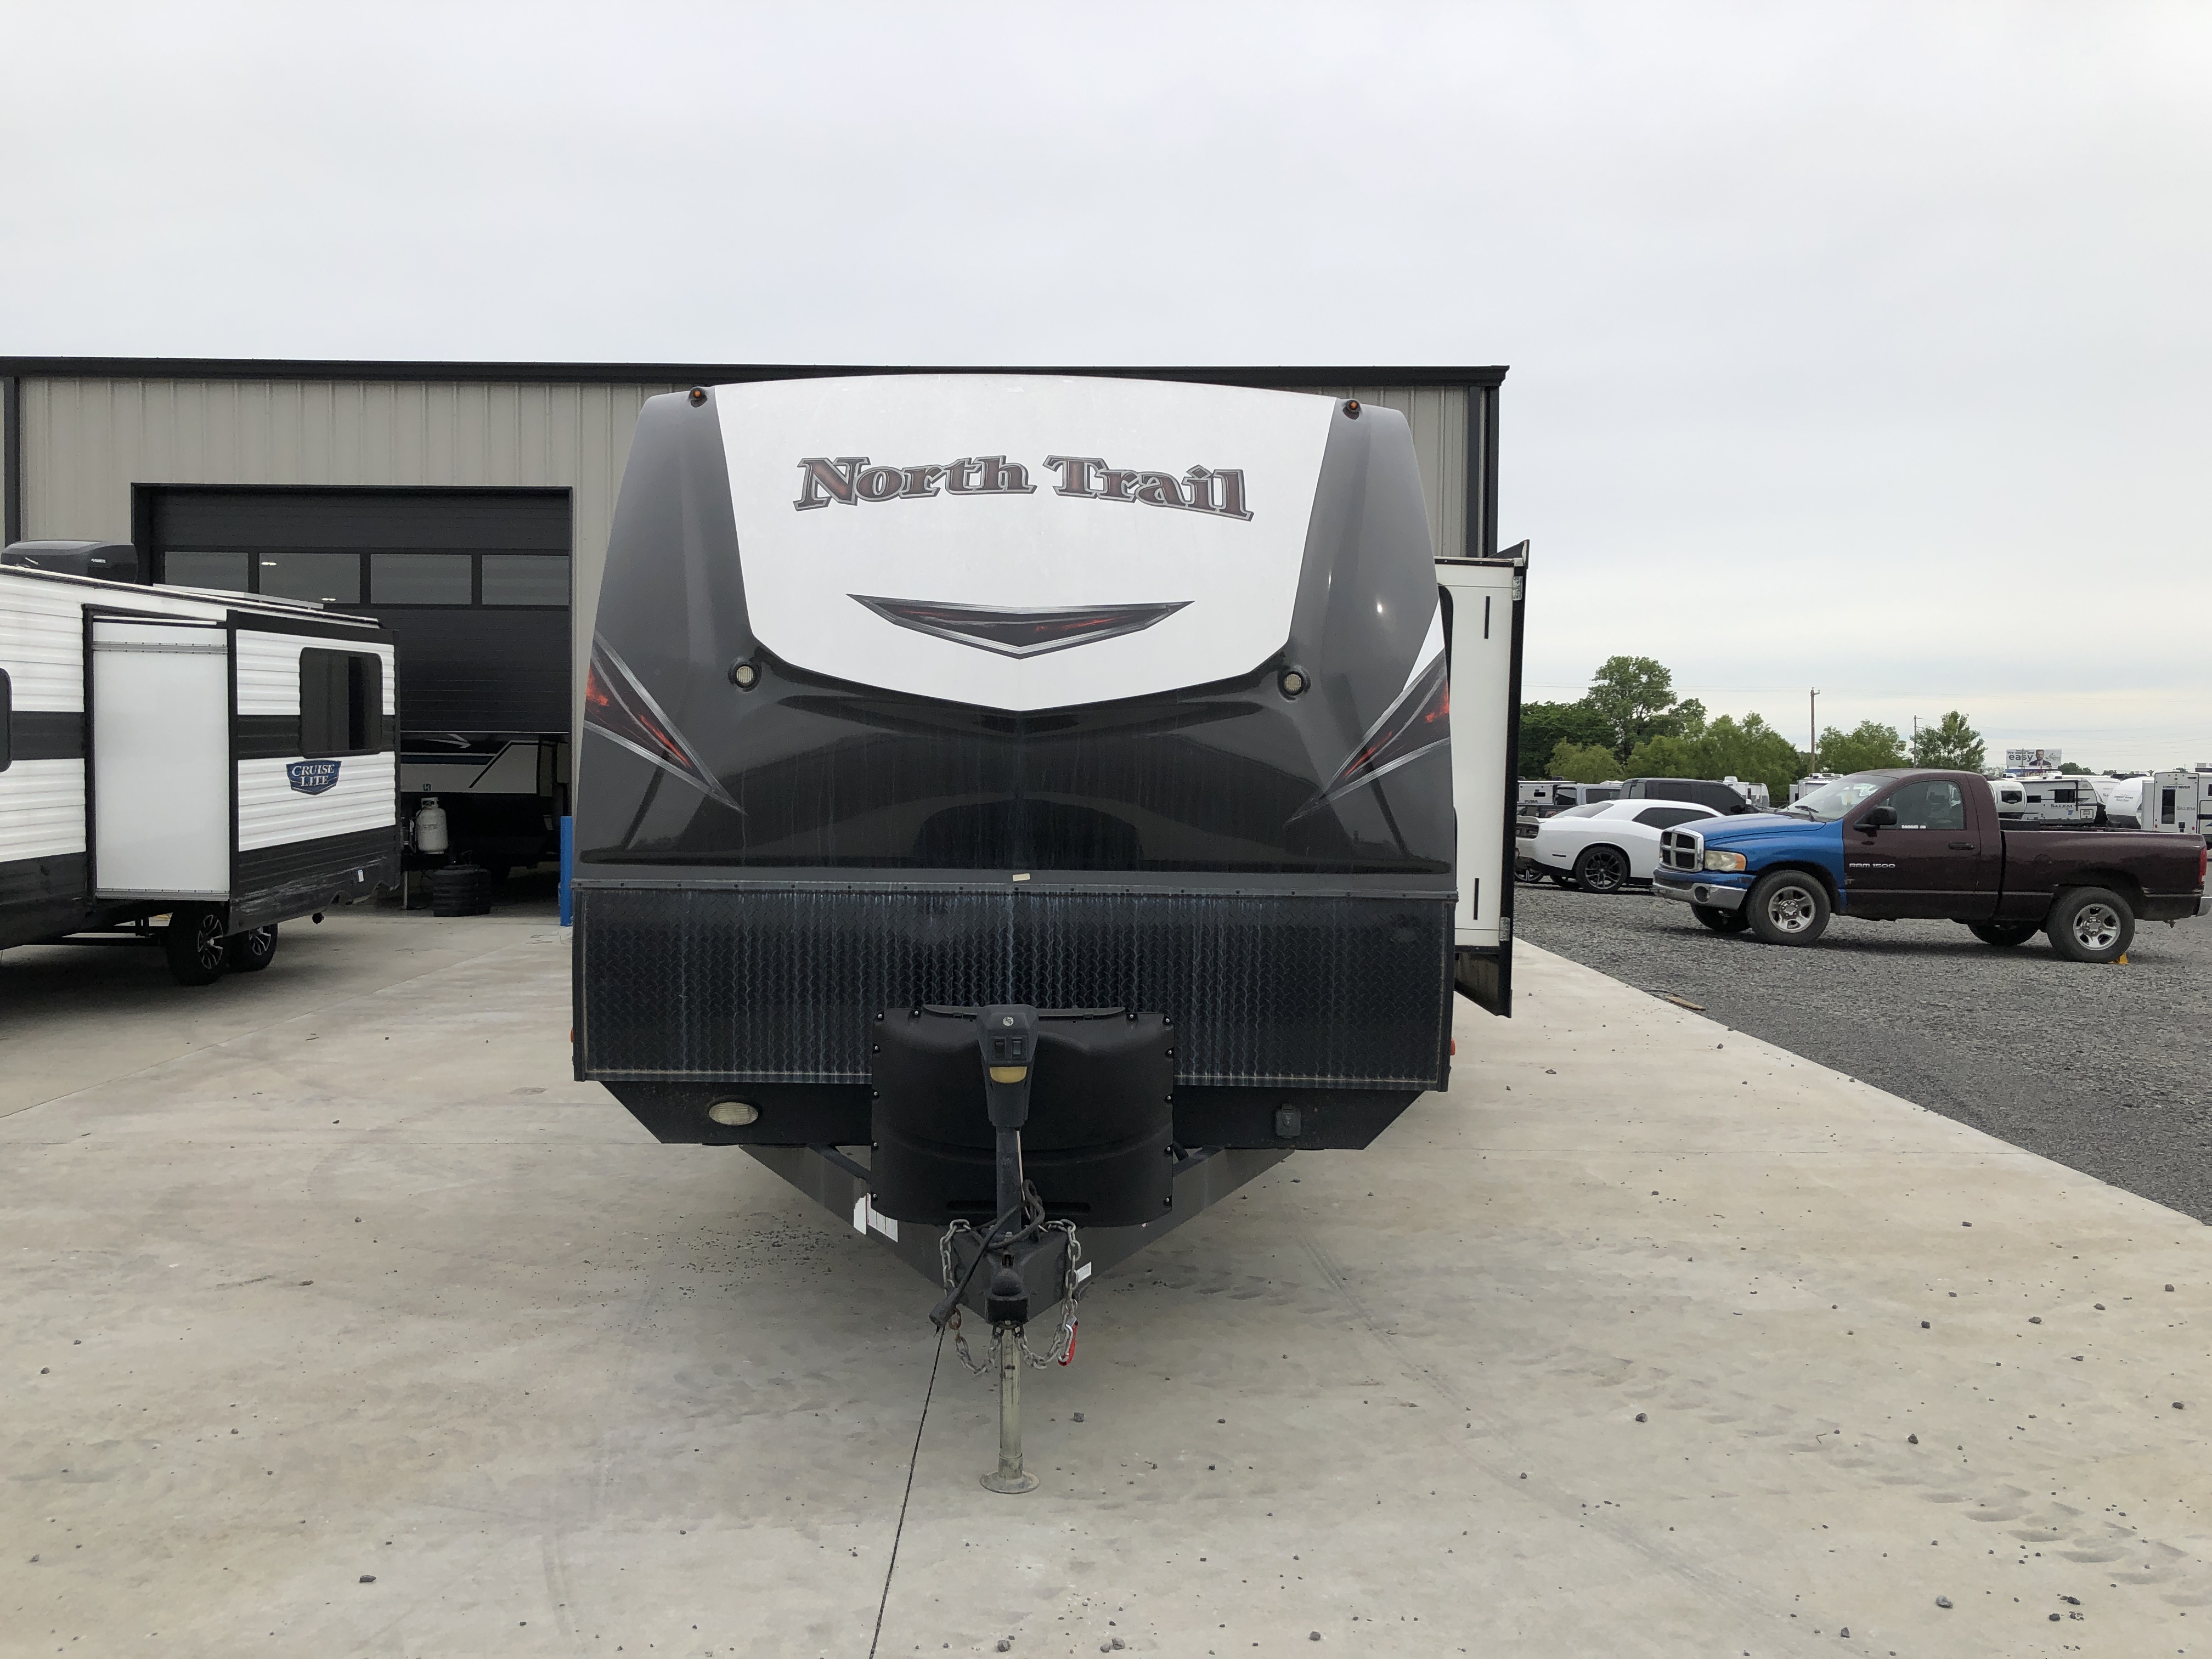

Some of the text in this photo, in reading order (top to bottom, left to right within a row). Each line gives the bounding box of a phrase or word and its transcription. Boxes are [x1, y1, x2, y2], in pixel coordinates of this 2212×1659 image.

[793, 454, 1254, 522] North Trail
[291, 764, 335, 777] CRUISE
[300, 775, 329, 787] LITE
